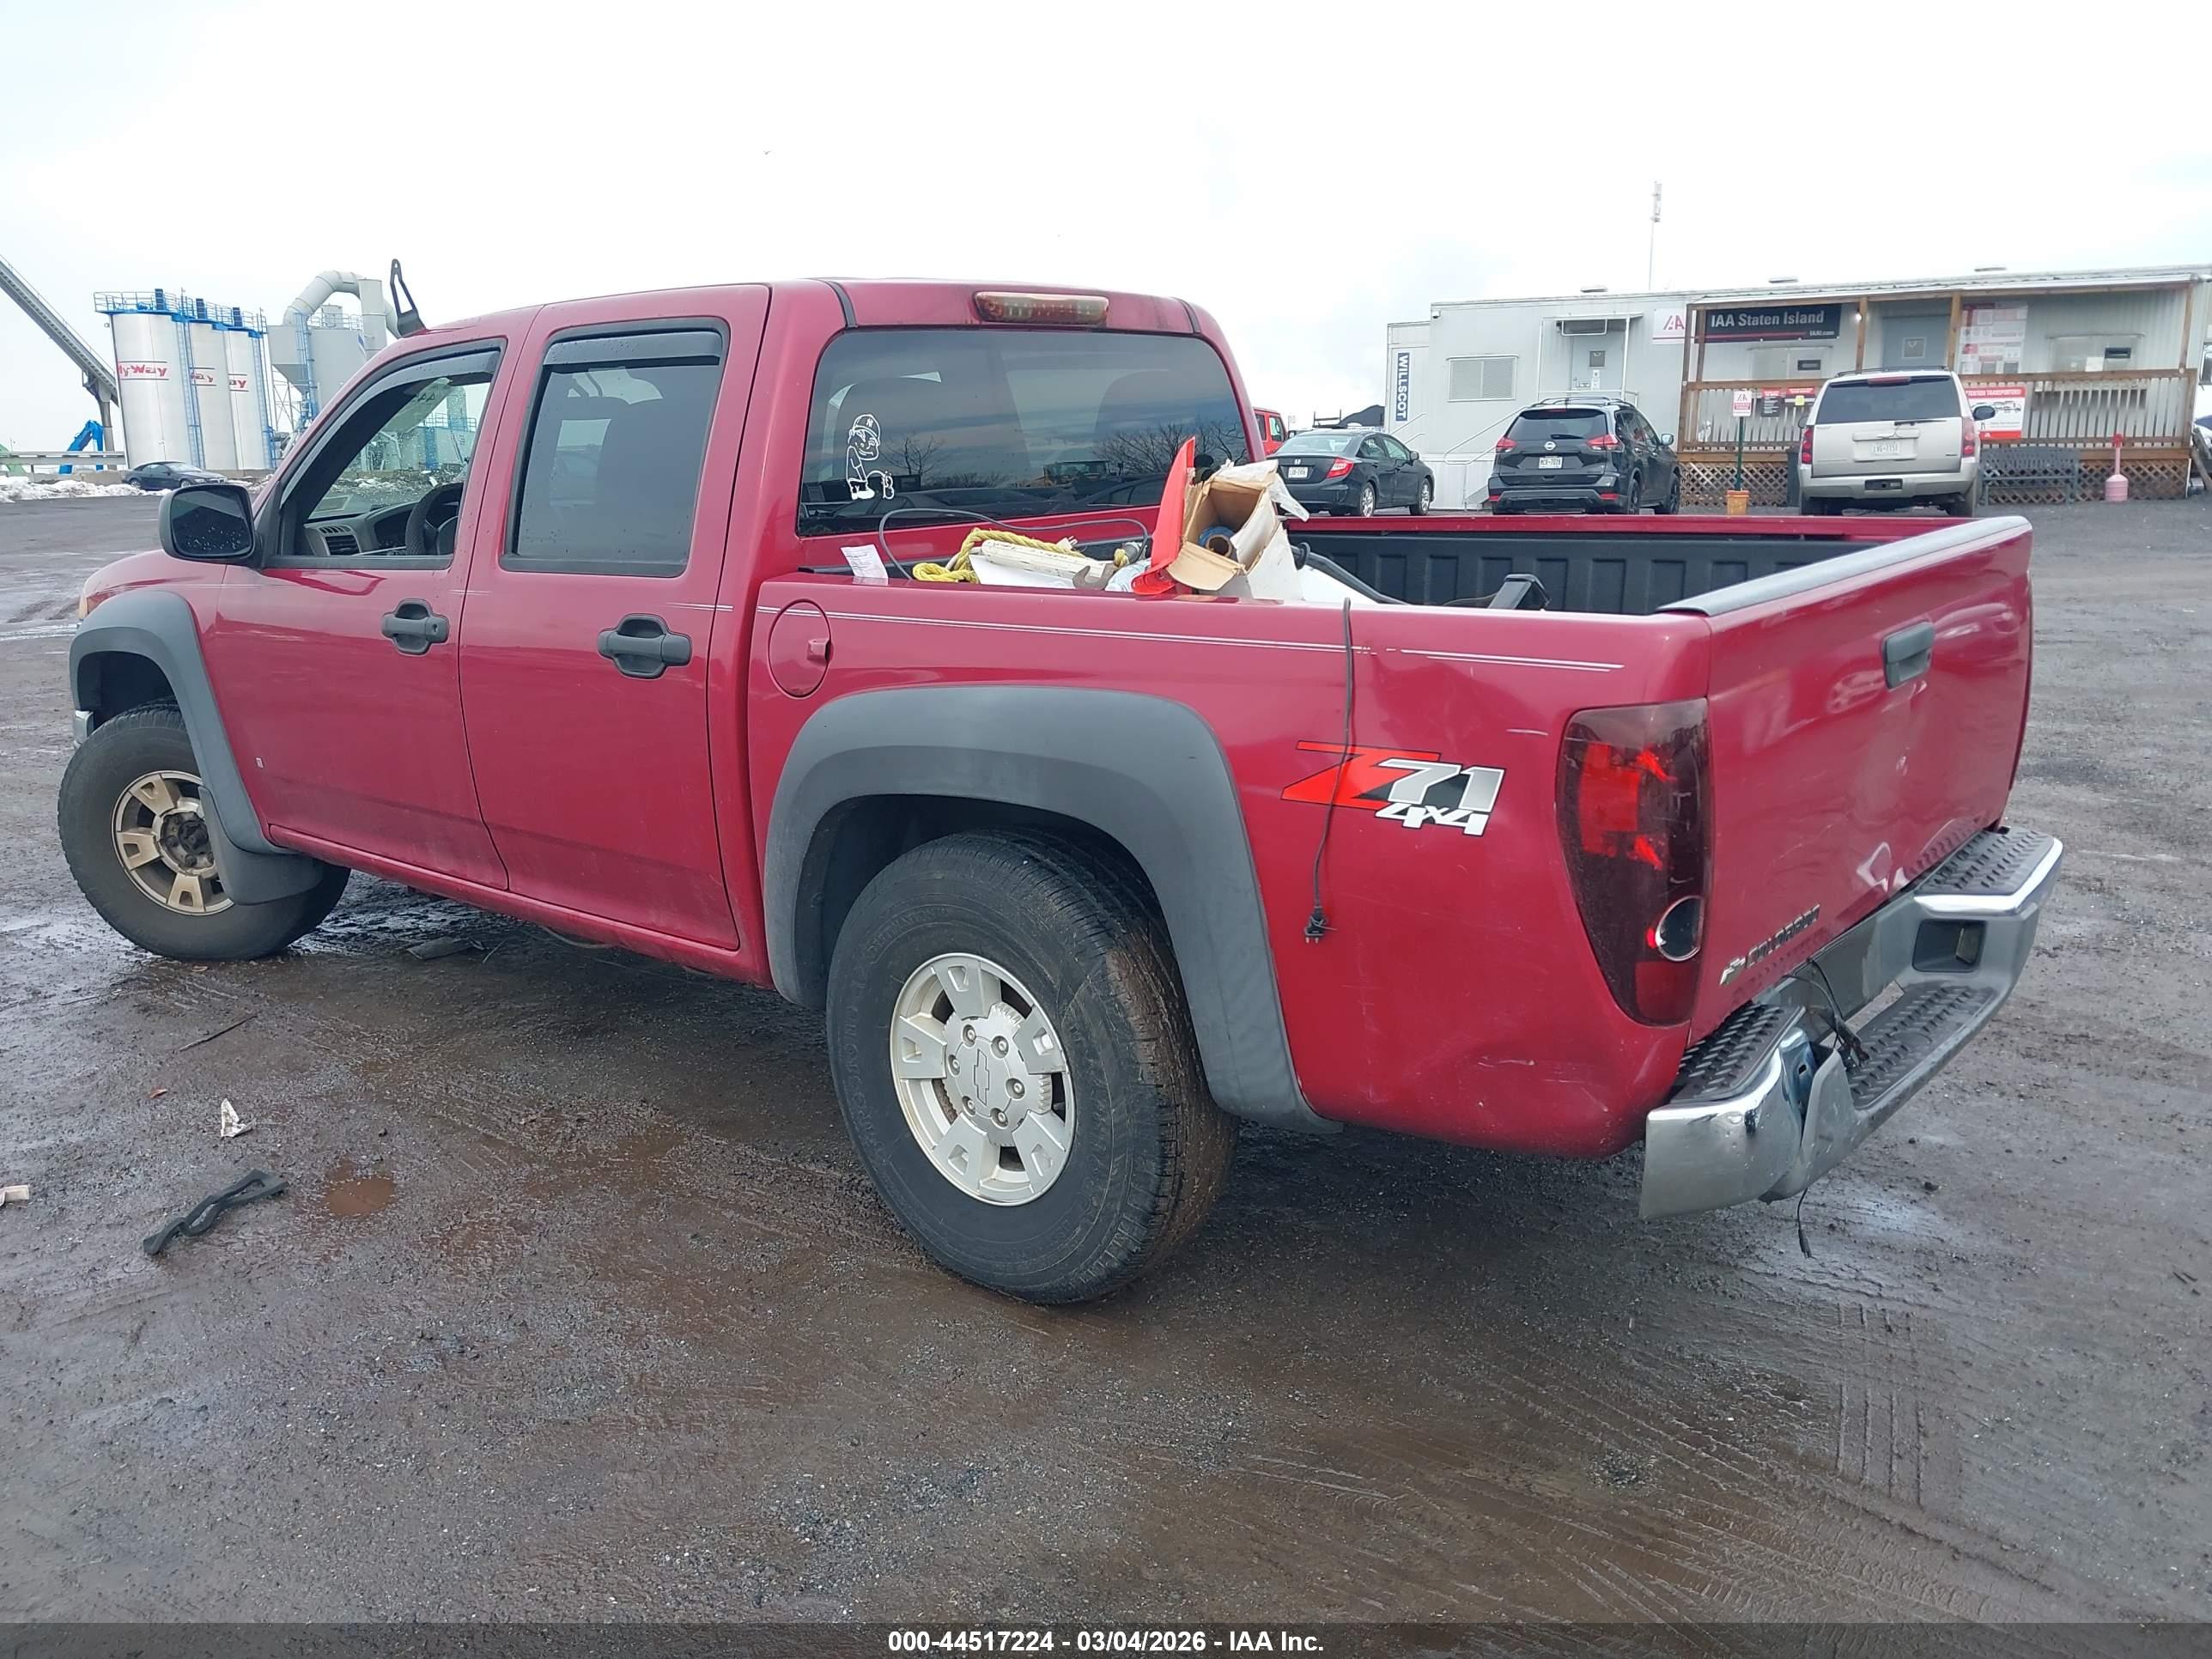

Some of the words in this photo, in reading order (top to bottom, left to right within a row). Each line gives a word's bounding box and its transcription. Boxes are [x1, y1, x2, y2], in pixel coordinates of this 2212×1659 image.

[1711, 314, 1735, 327] IAA
[1738, 313, 1780, 326] Staten
[1784, 310, 1825, 325] Island
[1396, 355, 1408, 419] WILLSCOT
[1280, 740, 1505, 813] Z71
